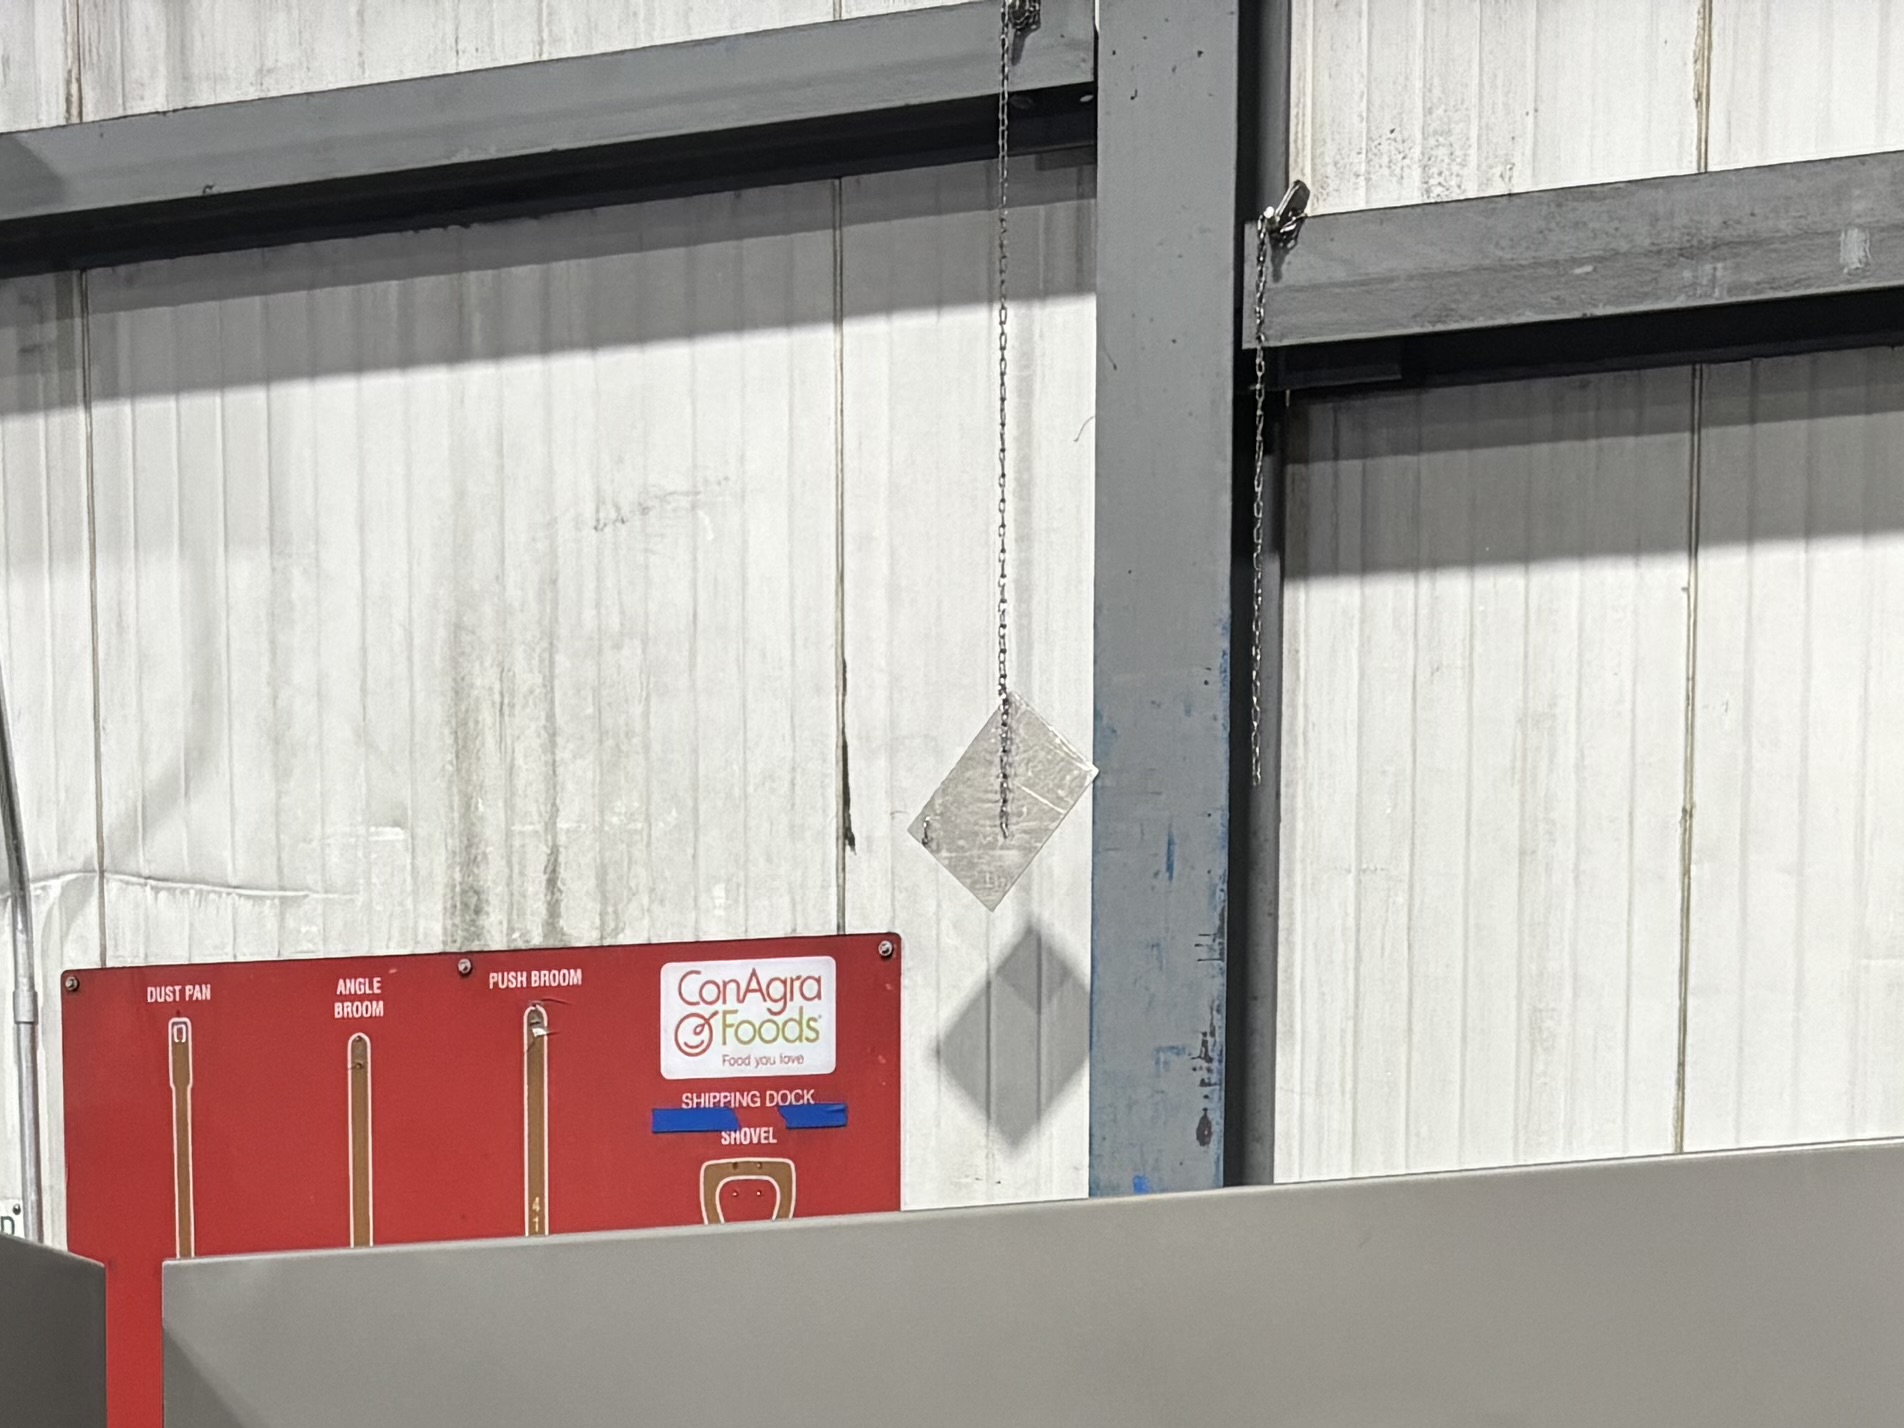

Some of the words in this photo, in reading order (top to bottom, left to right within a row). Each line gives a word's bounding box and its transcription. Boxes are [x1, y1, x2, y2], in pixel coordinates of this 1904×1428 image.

[336, 977, 382, 995] ANGLE
[488, 970, 527, 989] PUSH
[531, 968, 583, 987] BROOM
[147, 985, 182, 1003] DUST
[185, 983, 211, 1001] PAN
[677, 967, 822, 1016] ConAgra
[334, 1000, 384, 1018] BROOM
[721, 1006, 820, 1045] Foods
[721, 1053, 752, 1067] Food
[755, 1055, 777, 1069] you
[779, 1053, 804, 1066] love
[681, 1090, 761, 1109] SHIPPING
[766, 1088, 815, 1107] DOCK
[721, 1127, 777, 1145] SHOVEL
